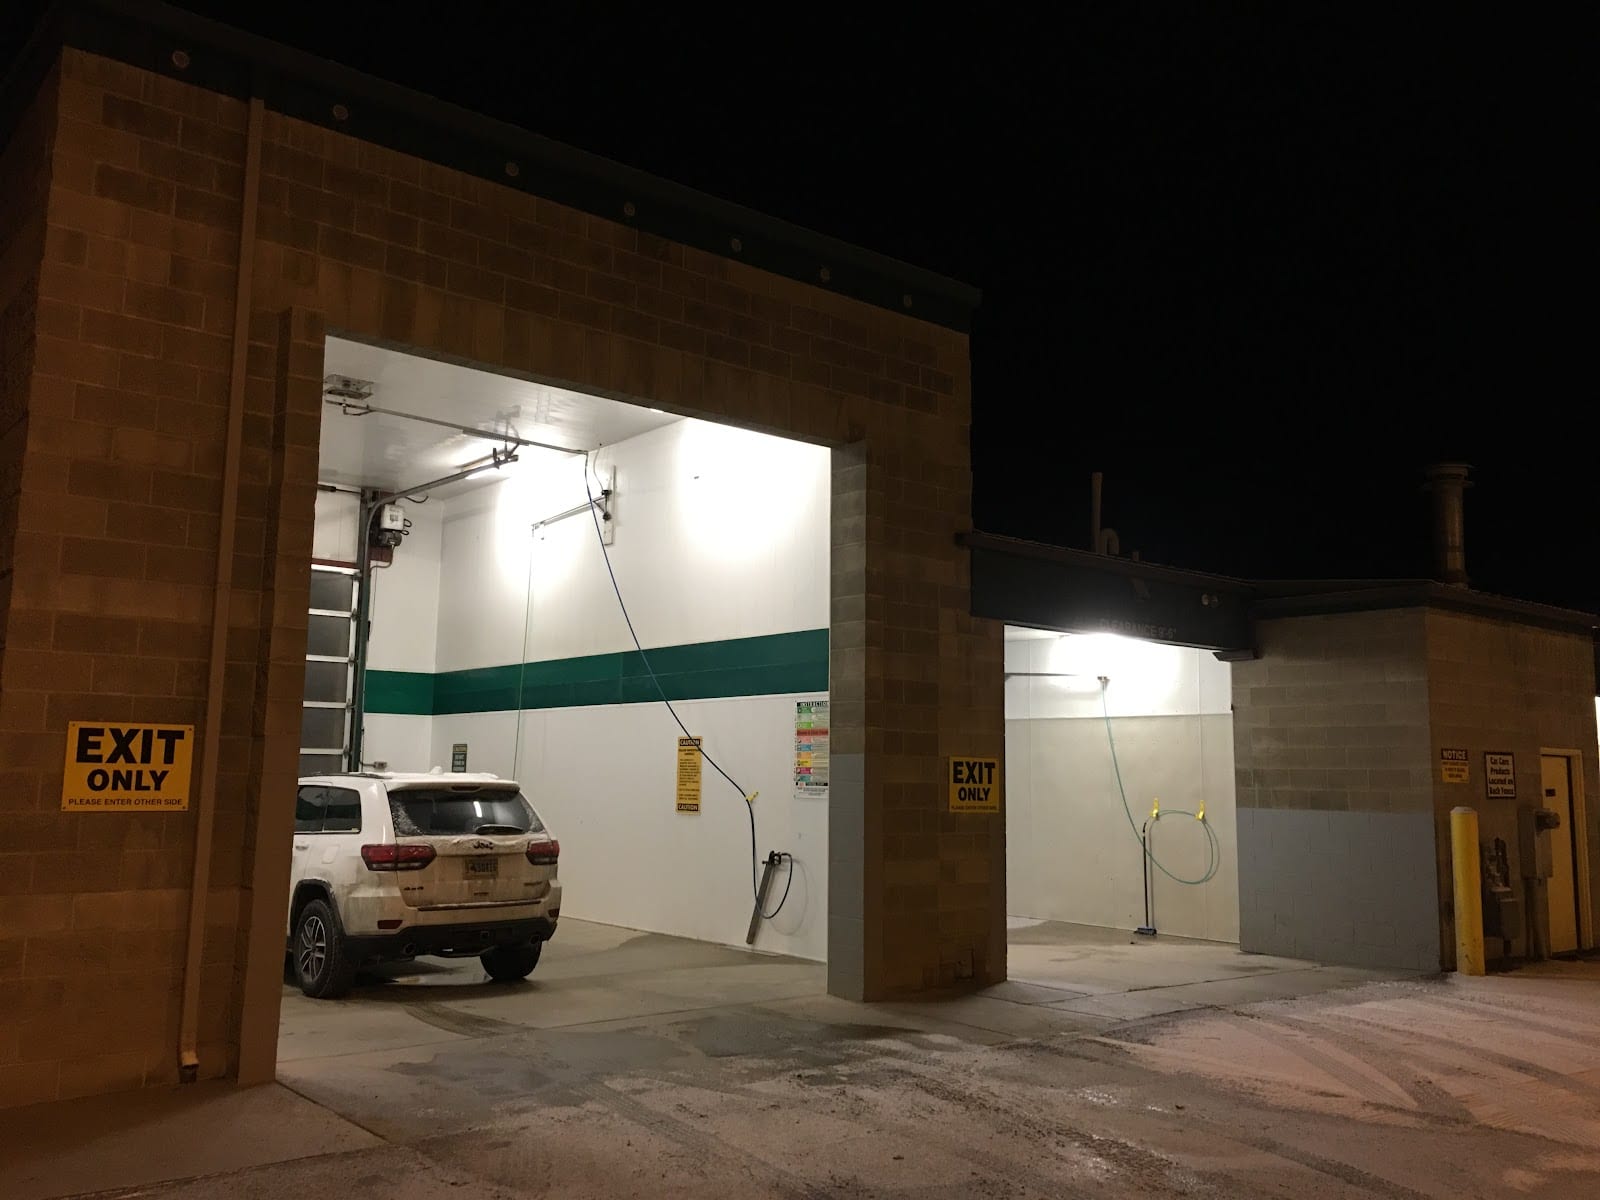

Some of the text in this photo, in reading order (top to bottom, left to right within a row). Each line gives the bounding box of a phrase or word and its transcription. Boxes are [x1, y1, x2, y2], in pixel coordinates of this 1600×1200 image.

[76, 728, 185, 764] EXIT
[1443, 750, 1466, 759] NOTICE
[87, 769, 169, 791] ONLY
[953, 761, 995, 784] EXIT
[134, 798, 162, 806] OTHER
[958, 786, 990, 801] ONLY
